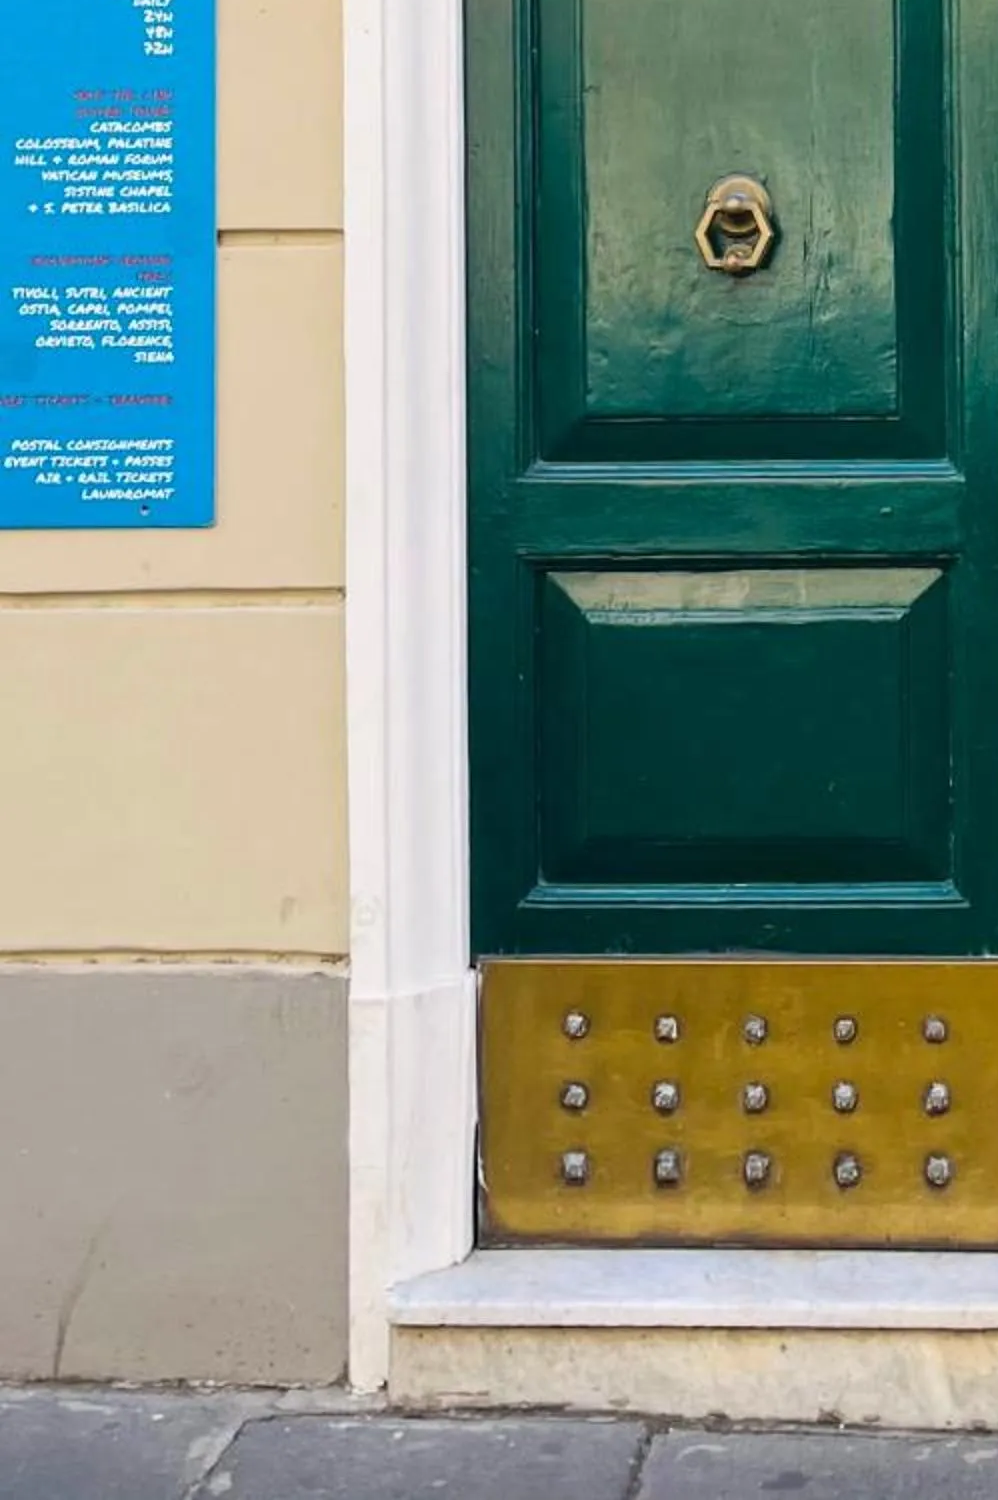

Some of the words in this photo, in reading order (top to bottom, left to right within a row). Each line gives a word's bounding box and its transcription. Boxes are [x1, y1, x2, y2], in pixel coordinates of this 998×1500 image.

[89, 120, 173, 133] CATACOMBS
[15, 137, 101, 151] COLOSSEUM,
[107, 137, 173, 151] PALATINE
[14, 153, 47, 166] HILL
[67, 153, 120, 166] ROMAN
[123, 153, 173, 166] FORUM
[41, 169, 98, 183] VATICAN
[102, 169, 173, 183] MUSEUMS,
[63, 185, 115, 198] SISTINE
[119, 185, 173, 198] CHAPEL
[61, 201, 103, 214] PETER
[108, 201, 171, 214] BASILICA
[12, 286, 59, 301] TIVOLI,
[112, 286, 173, 301] ANCIENT
[18, 302, 62, 317] OSTIA,
[67, 302, 111, 317] CAPRI,
[50, 318, 122, 333] SORRENTO,
[127, 318, 173, 333] ASSISI,
[35, 335, 95, 349] ORVIETO,
[101, 335, 173, 349] FLORENCE,
[134, 351, 175, 363] SIENA
[11, 439, 62, 451] POSTAL
[66, 439, 174, 451] CONSIGNMENTS
[3, 455, 48, 468] EVENT
[50, 455, 109, 468] TICKETS
[124, 455, 174, 468] PASSES
[35, 471, 61, 484] AIR
[77, 471, 111, 484] RAIL
[116, 471, 174, 484] TICKETS
[81, 488, 174, 501] LAUNDROMAT
